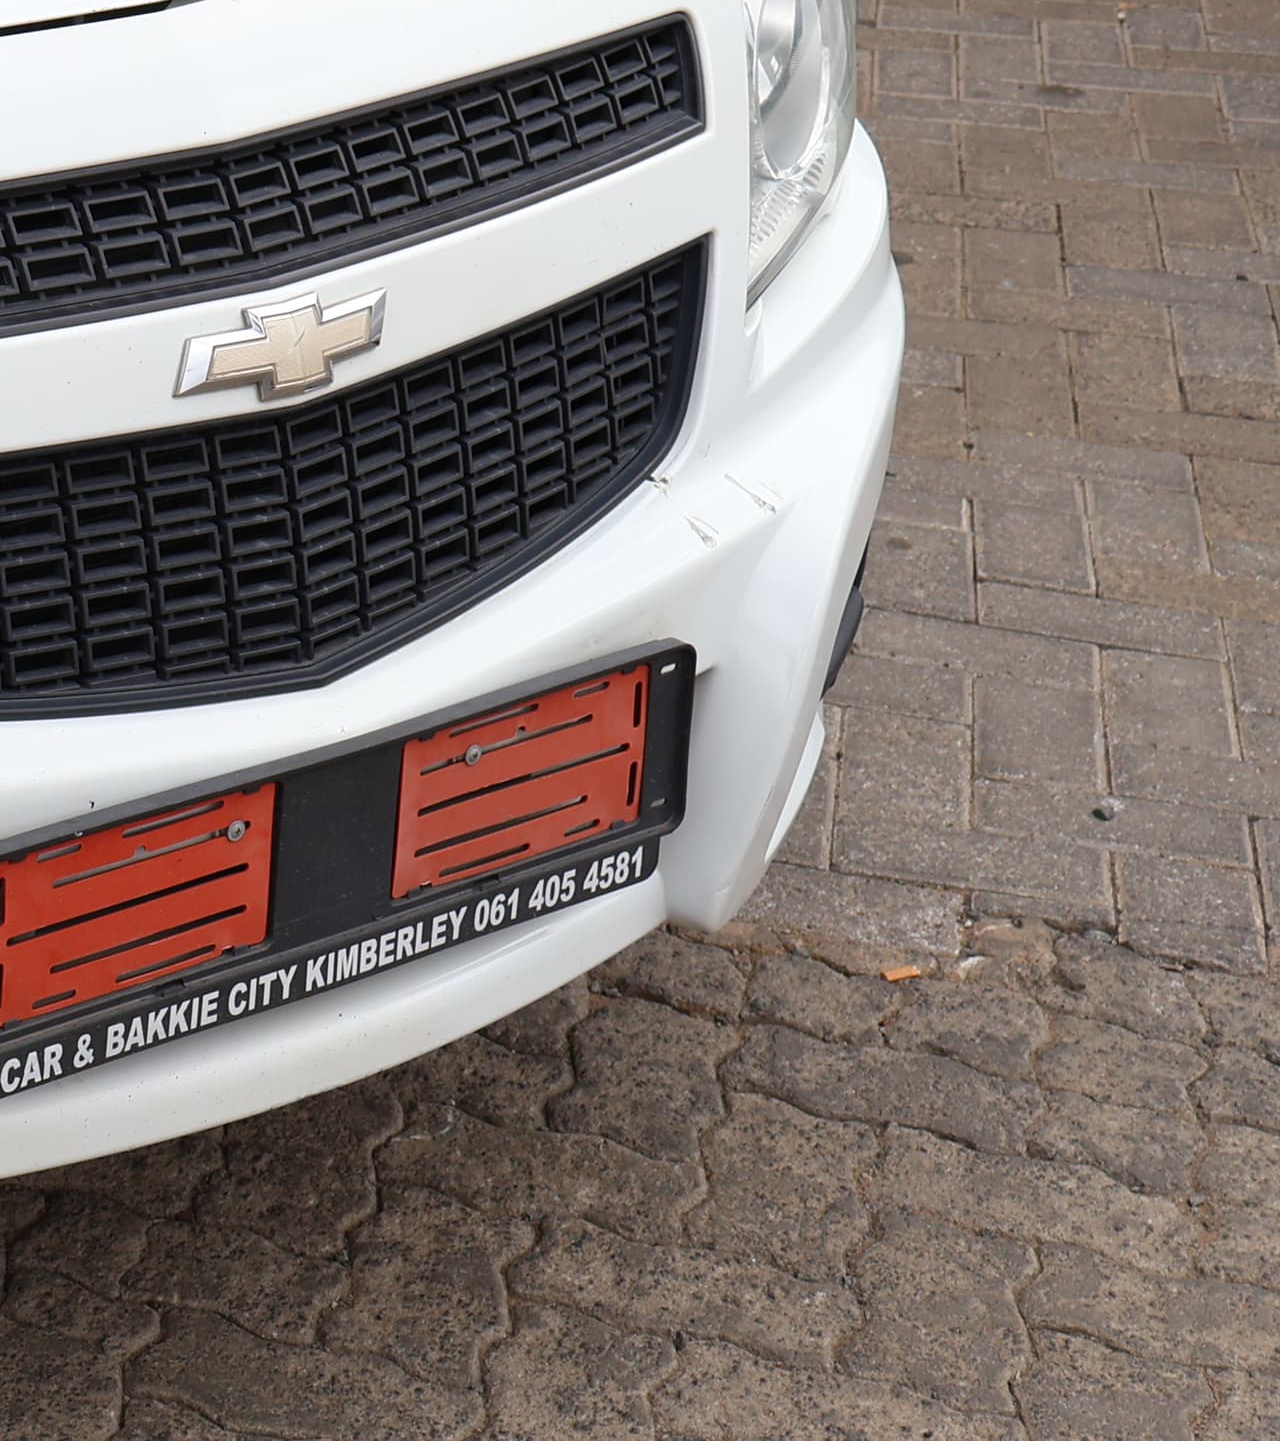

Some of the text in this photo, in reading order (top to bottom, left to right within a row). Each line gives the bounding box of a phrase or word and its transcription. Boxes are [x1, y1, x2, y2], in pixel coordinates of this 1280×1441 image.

[0, 845, 645, 1094] CAR & BAKKIE CITY KIMBERLEY 061 405 4581
